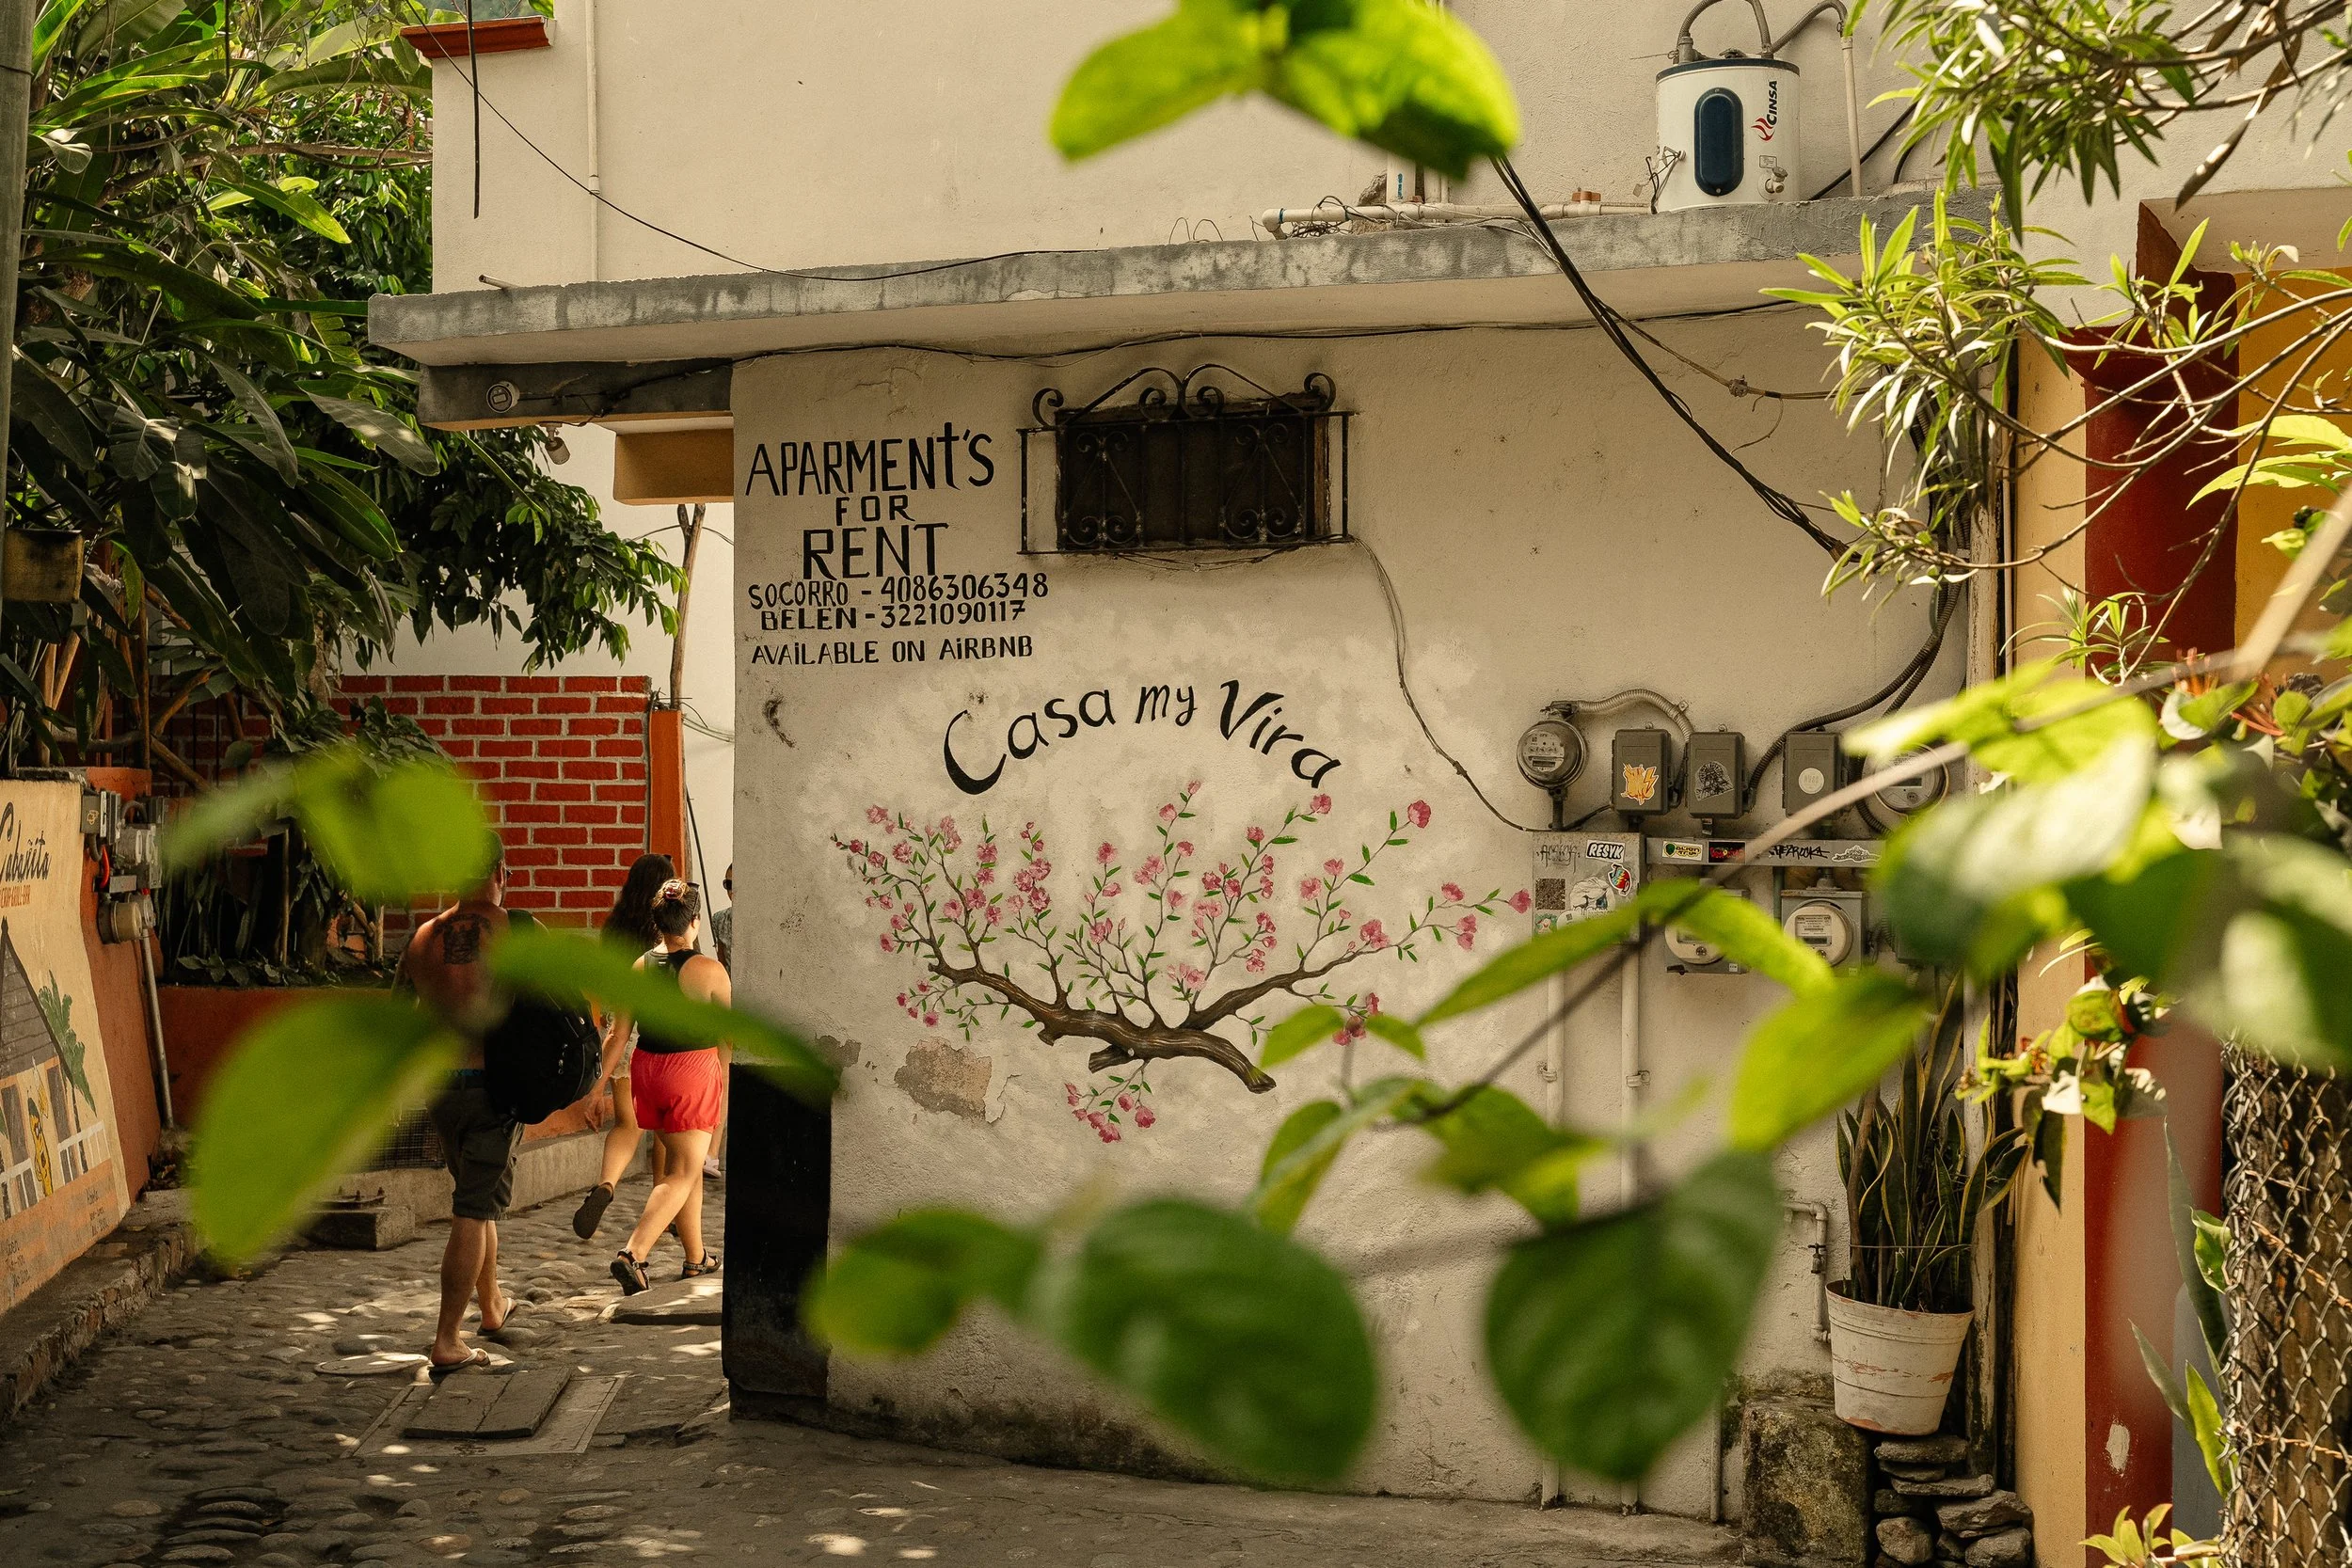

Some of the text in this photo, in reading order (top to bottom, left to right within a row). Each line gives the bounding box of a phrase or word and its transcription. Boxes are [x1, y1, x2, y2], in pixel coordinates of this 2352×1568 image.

[1766, 80, 1777, 125] CINSA
[835, 494, 915, 526] FOR
[803, 523, 949, 580] RENT
[748, 580, 849, 610] SOCORRO
[880, 572, 1049, 604] 4086306348
[760, 608, 857, 631] BELEN
[892, 640, 926, 662] ON
[944, 679, 1342, 795] Casa my Vira
[1587, 842, 1625, 860] RESYK
